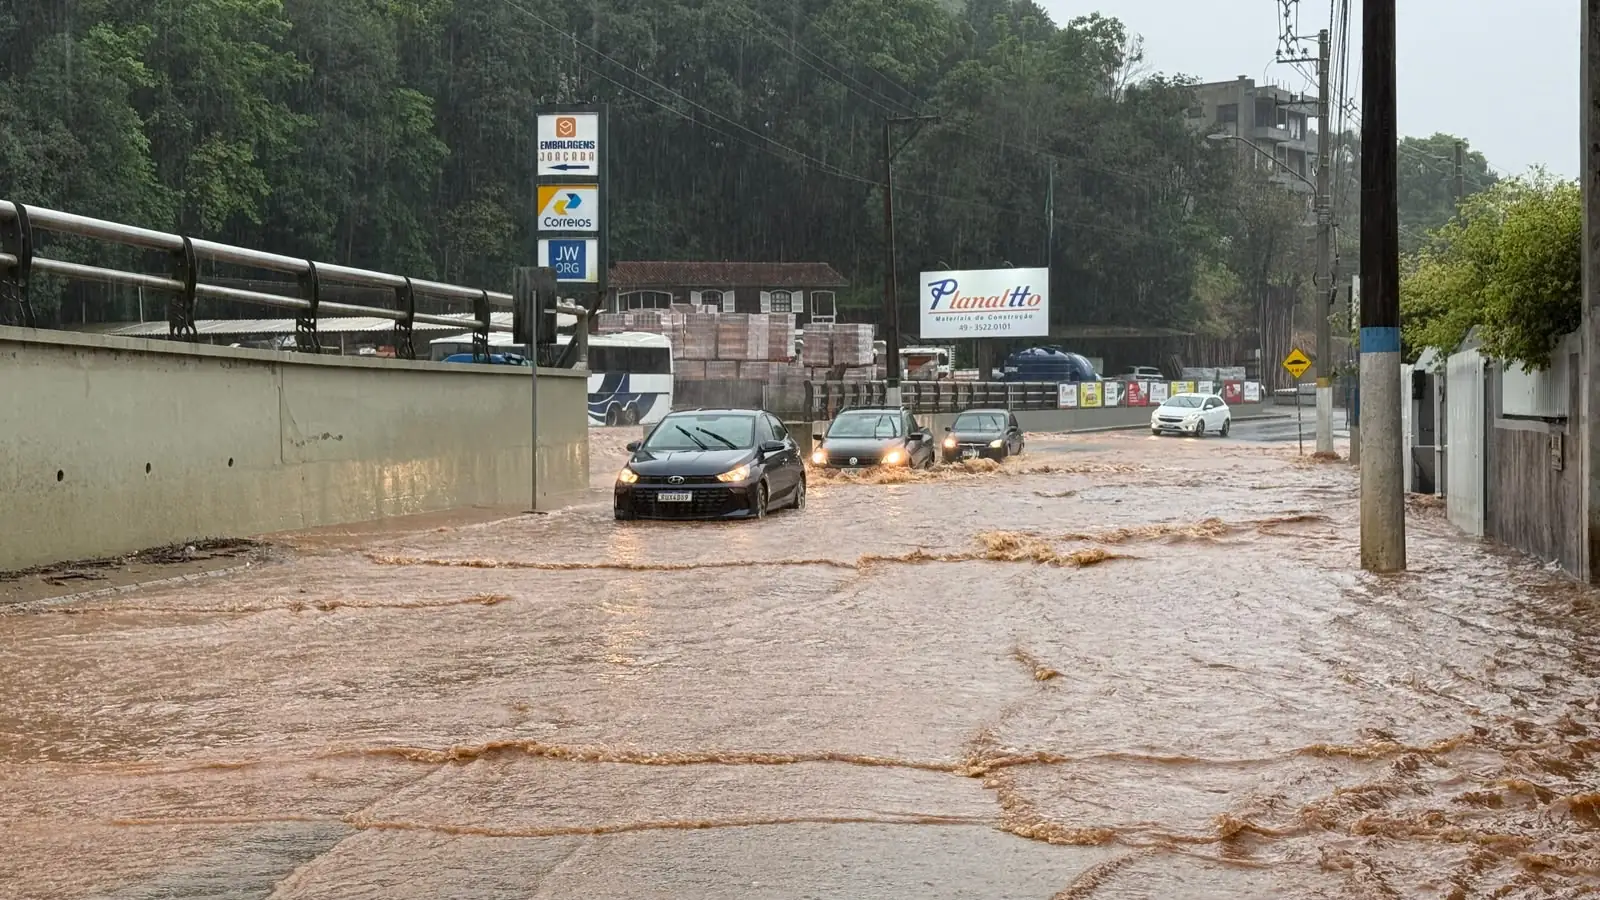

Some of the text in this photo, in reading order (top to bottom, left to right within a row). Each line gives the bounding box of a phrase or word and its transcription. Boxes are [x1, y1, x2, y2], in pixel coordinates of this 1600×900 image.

[540, 140, 595, 150] EMBALAGENS
[543, 216, 592, 228] Correios
[555, 245, 579, 261] JW
[555, 262, 580, 273] ORG
[928, 278, 1041, 310] Planaltto
[988, 313, 1033, 321] Construção
